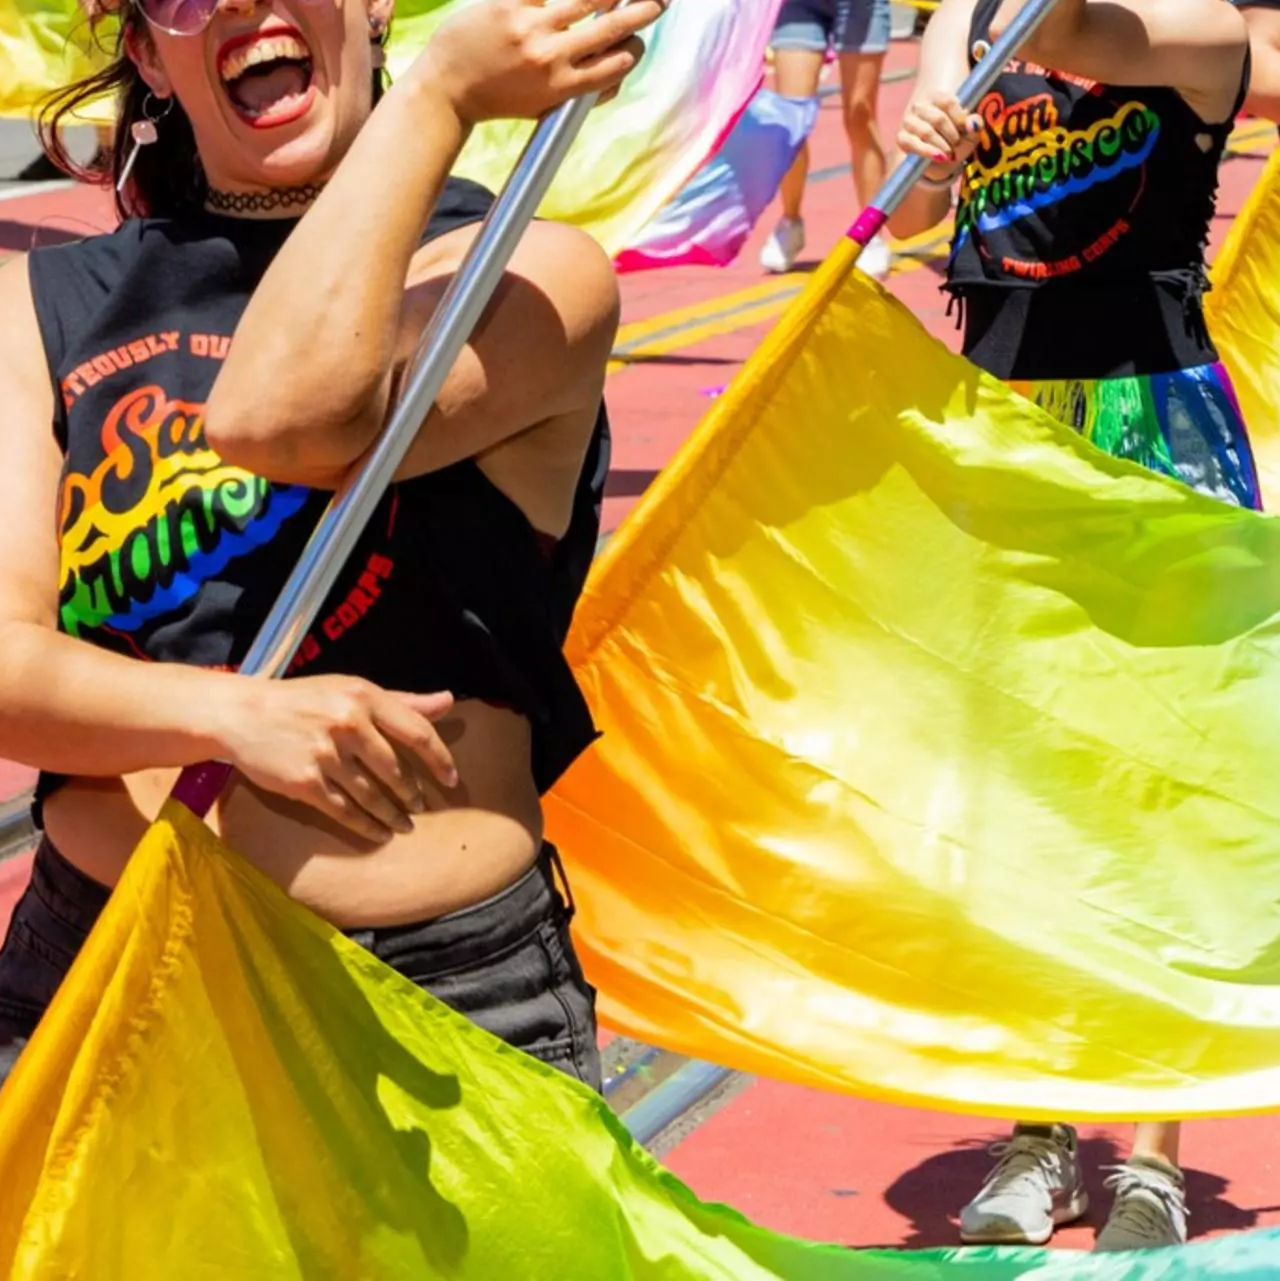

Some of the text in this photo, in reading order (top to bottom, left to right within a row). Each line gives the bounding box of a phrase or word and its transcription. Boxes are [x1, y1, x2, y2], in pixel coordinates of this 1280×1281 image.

[958, 106, 1156, 225] ancisco
[976, 93, 1059, 169] San
[101, 384, 209, 515] Sa
[321, 552, 395, 642] CORPS
